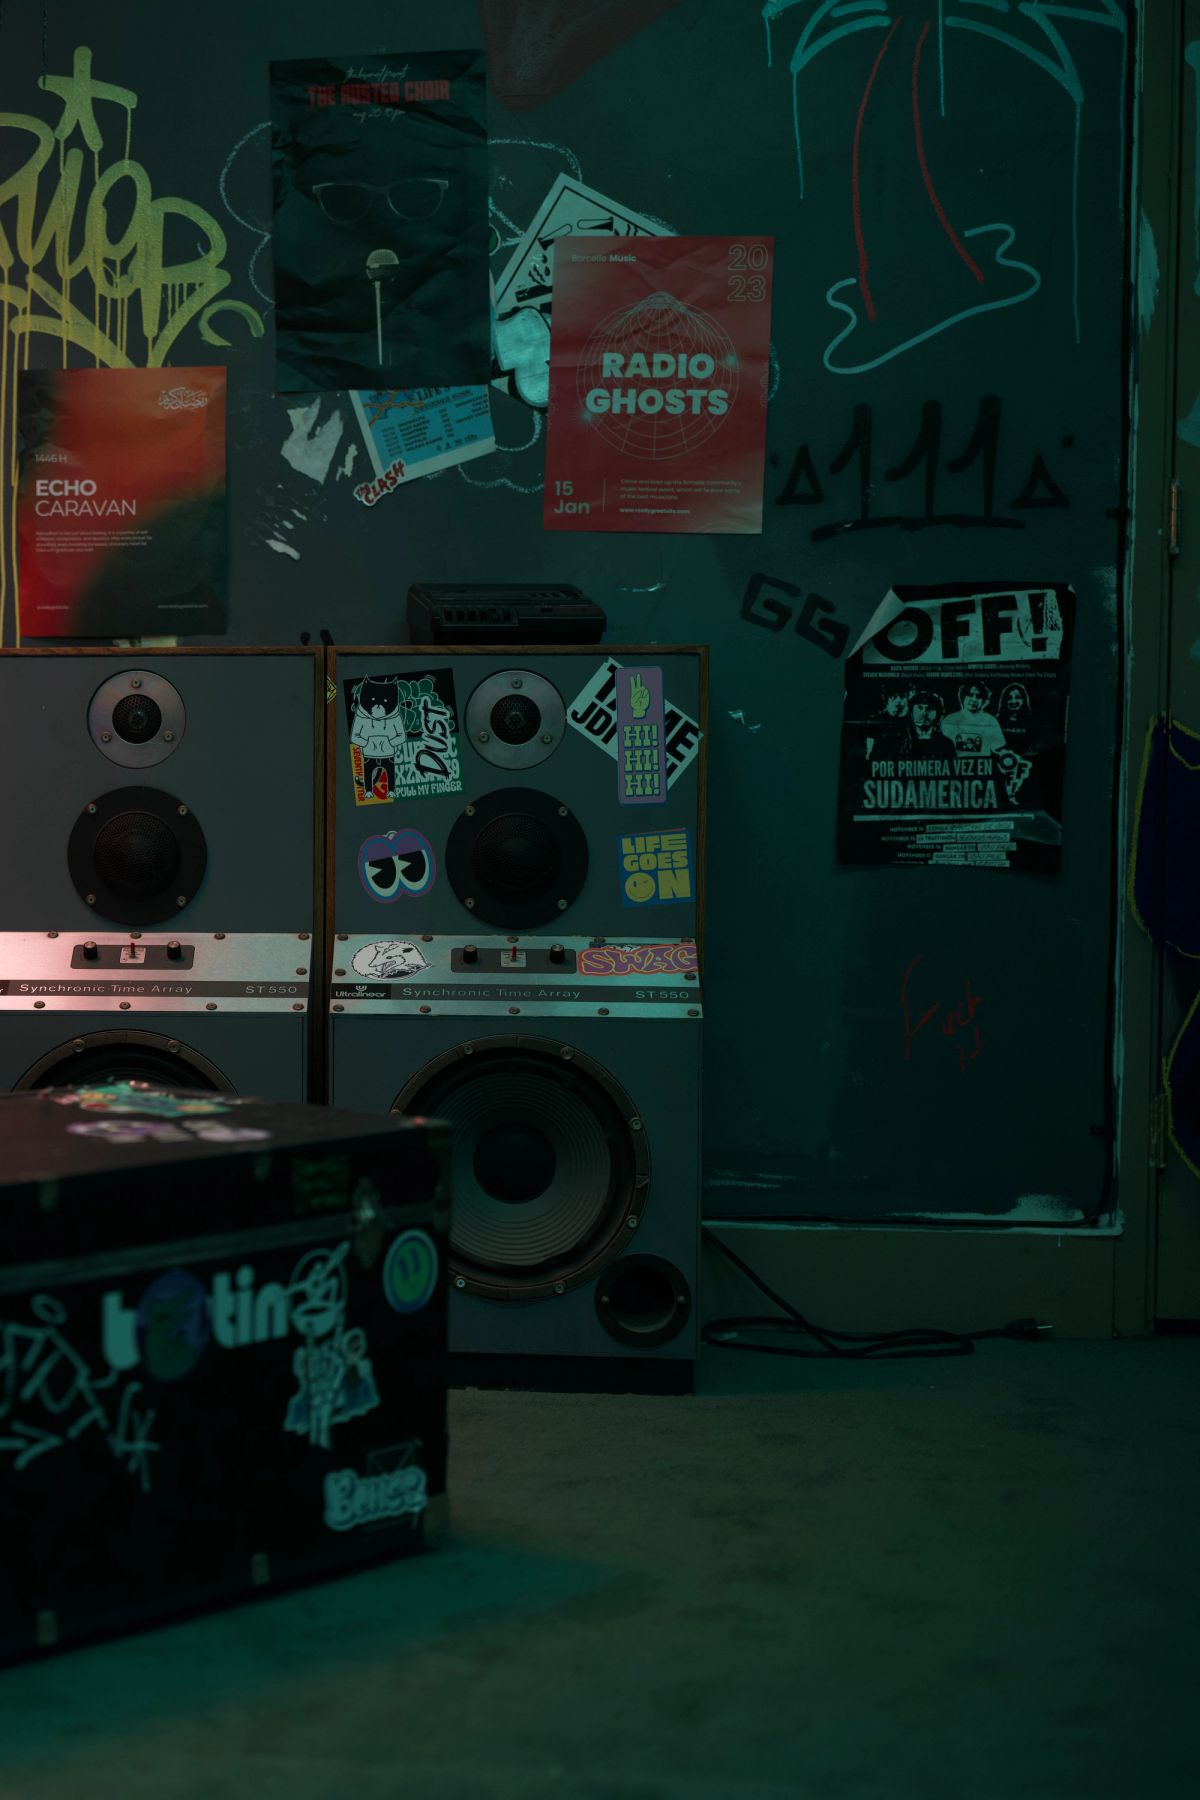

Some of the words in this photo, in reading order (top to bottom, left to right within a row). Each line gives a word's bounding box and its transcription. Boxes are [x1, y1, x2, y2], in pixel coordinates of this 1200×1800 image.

[305, 83, 336, 111] THE
[608, 253, 637, 263] Music
[728, 244, 768, 271] 20
[728, 275, 766, 302] 23
[602, 352, 716, 379] RADIO
[585, 388, 729, 415] GHOSTS
[35, 479, 97, 497] ECHO
[365, 460, 405, 504] CLASH
[554, 480, 573, 496] 15
[35, 499, 136, 517] CARAVAN
[553, 500, 590, 514] Jan
[872, 592, 1049, 661] OFF!
[623, 724, 659, 748] HI!
[624, 749, 660, 772] HI!
[872, 760, 895, 777] POR
[898, 760, 950, 777] PRIMERA
[953, 759, 976, 776] VEZ
[978, 759, 993, 775] EN
[395, 786, 417, 798] PULL
[417, 784, 430, 796] MY
[430, 781, 462, 793] FINGER
[624, 773, 661, 797] HI!
[863, 778, 998, 809] SUDAMERICA
[621, 833, 688, 854] LIFE
[623, 851, 689, 872] GOES
[19, 983, 105, 994] Synchronic
[112, 984, 145, 994] Time
[151, 984, 194, 996] Array
[335, 990, 387, 998] Ultralinear
[402, 987, 491, 999] Synchronic
[496, 988, 531, 998] Time
[539, 989, 581, 999] Array
